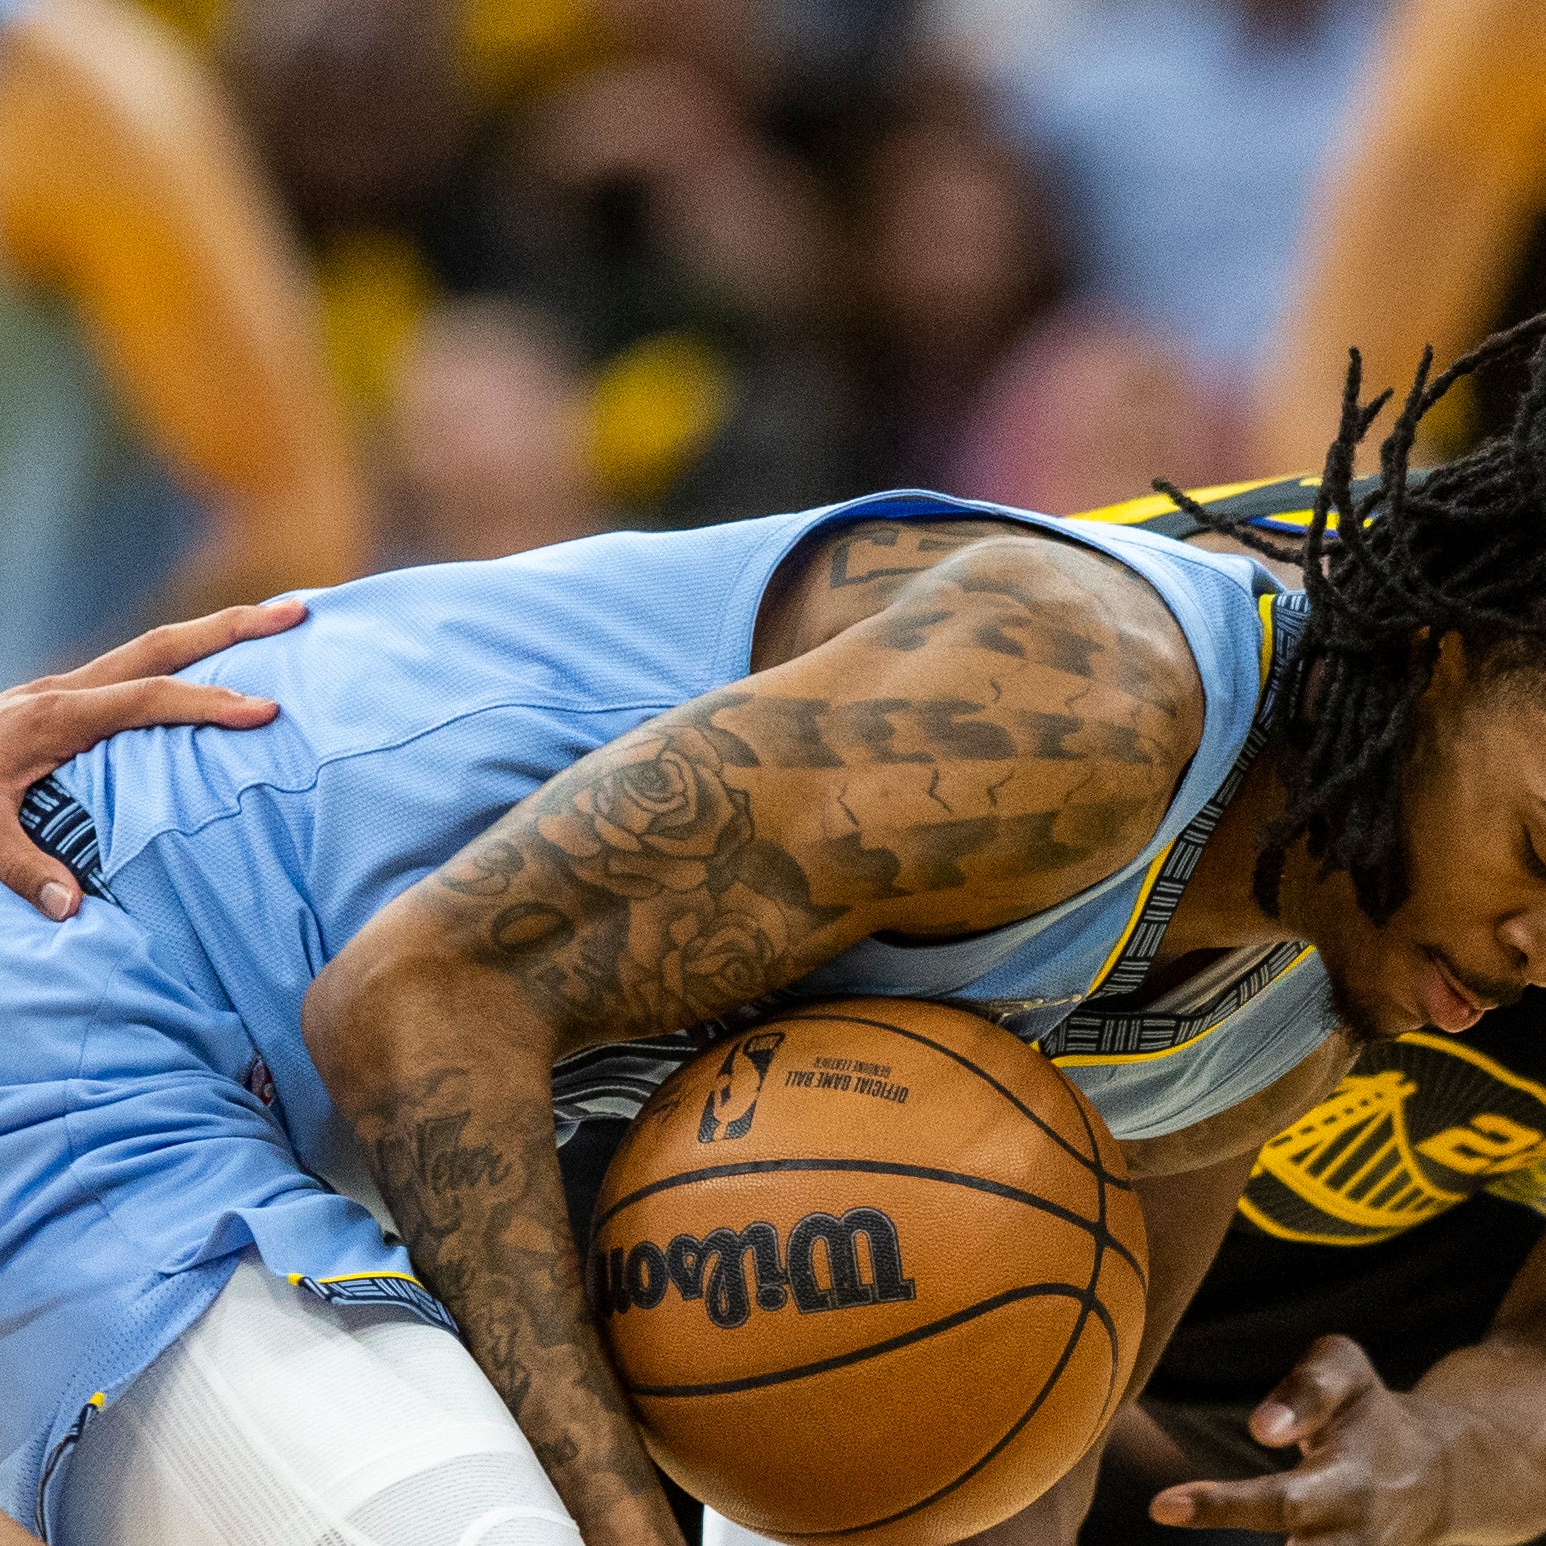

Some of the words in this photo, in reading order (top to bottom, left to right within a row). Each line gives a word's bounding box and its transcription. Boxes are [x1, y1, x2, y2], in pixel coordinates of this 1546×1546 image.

[784, 1070, 815, 1088] BALL
[815, 1072, 852, 1092] GAME
[854, 1077, 909, 1104] OFFICIAL
[597, 1206, 917, 1330] Wilson
